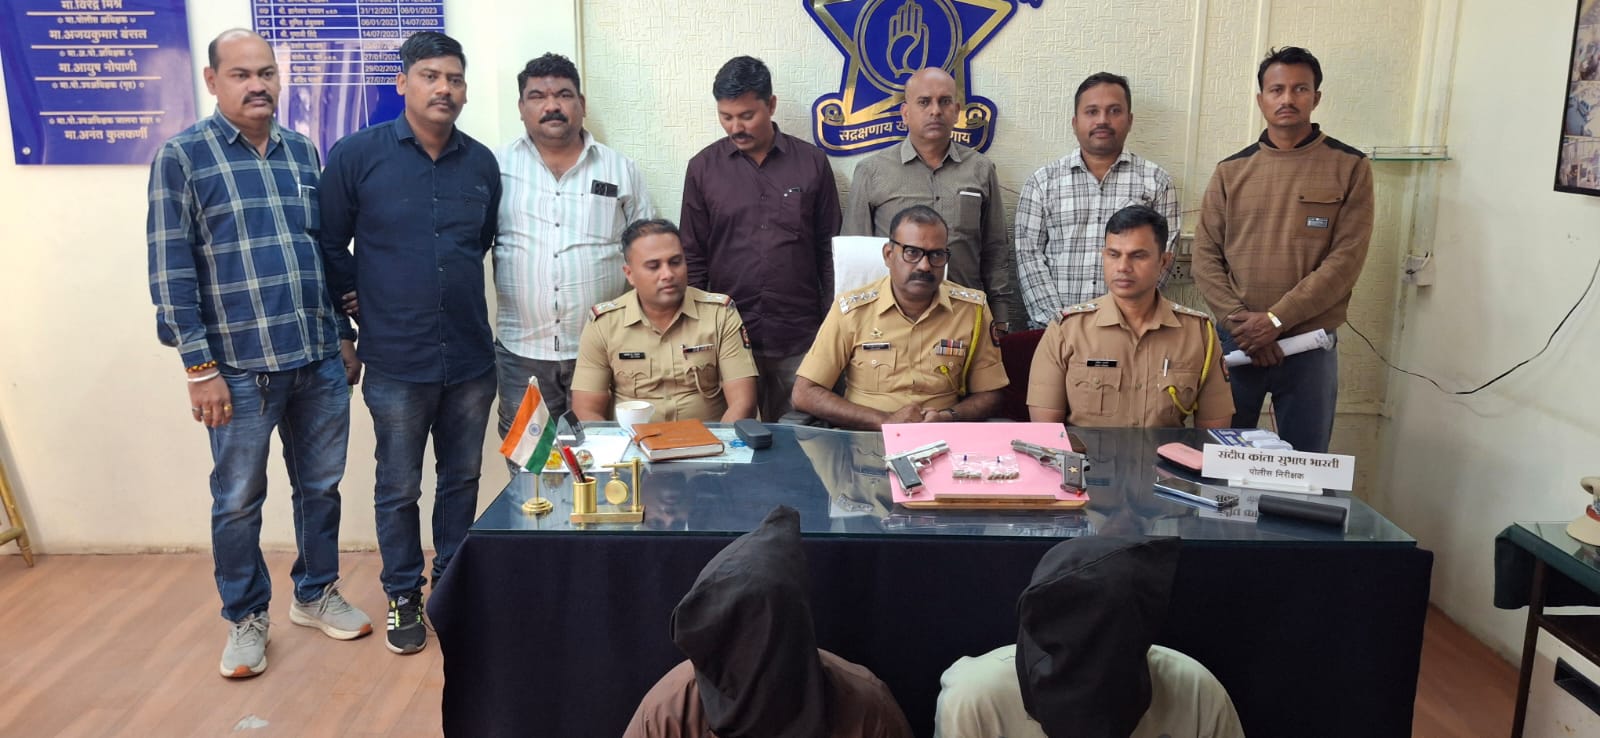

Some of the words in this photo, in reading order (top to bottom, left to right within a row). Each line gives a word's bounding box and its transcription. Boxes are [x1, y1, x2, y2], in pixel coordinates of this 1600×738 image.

[48, 29, 118, 43] मा.अजयकुमार
[120, 26, 147, 39] बंसल
[104, 60, 137, 73] नोपाणी
[64, 127, 104, 140] मा.अनंत
[1217, 450, 1246, 461] संदीप
[1248, 451, 1274, 463] कांता
[1277, 456, 1307, 467] सुभाष
[1309, 456, 1340, 469] भारती
[1249, 467, 1273, 477] पोलीस
[1275, 469, 1305, 480] निरीक्षक
